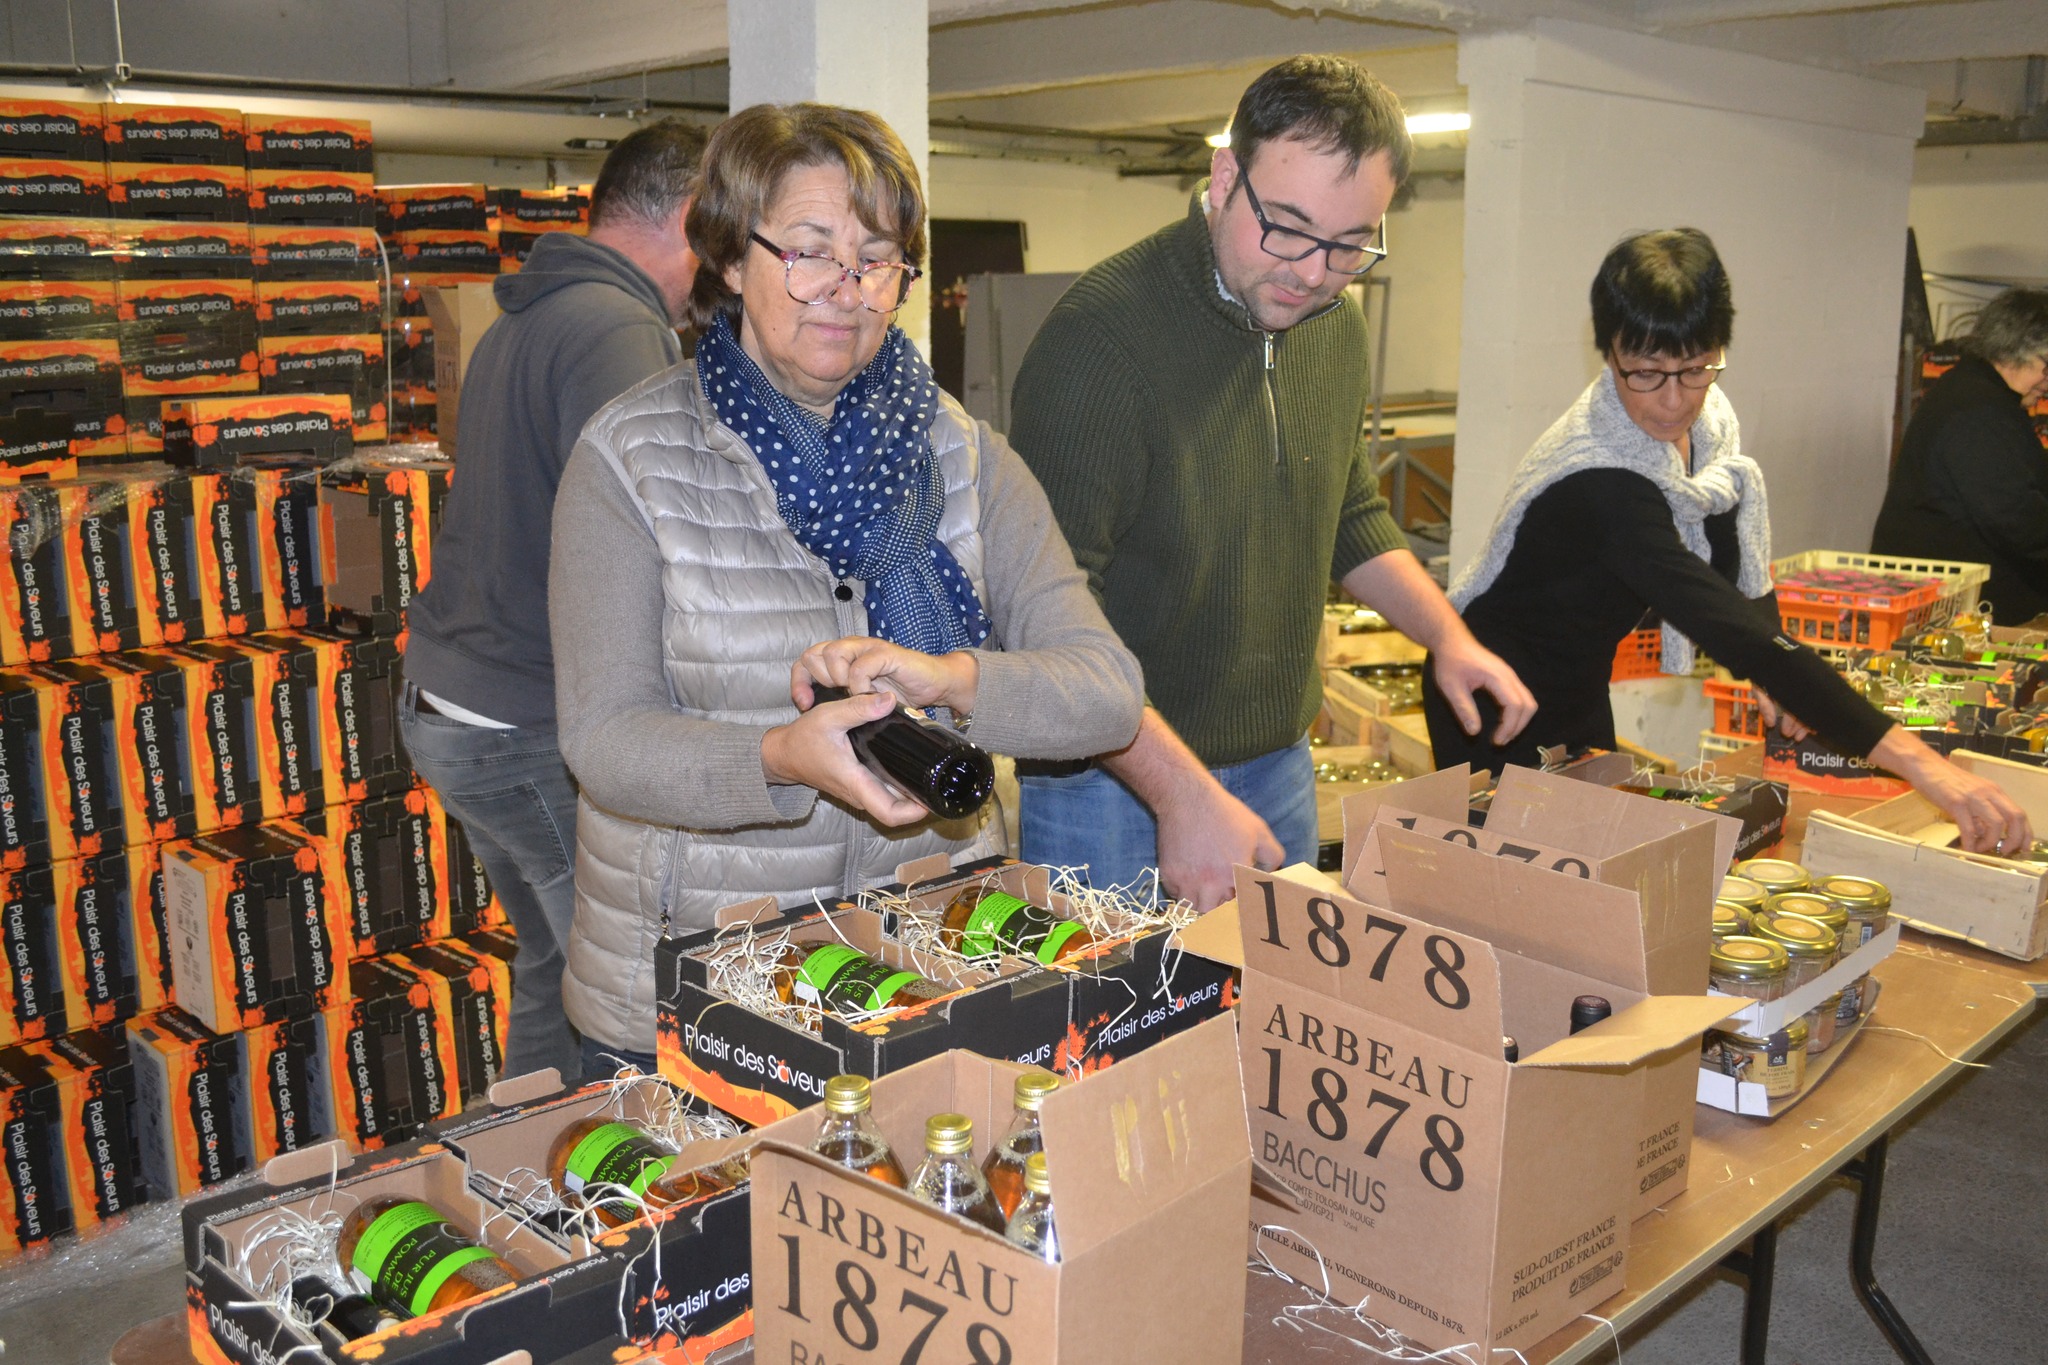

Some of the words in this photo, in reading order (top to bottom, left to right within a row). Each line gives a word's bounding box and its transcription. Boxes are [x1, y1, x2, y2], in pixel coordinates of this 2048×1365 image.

[20, 123, 42, 135] des
[43, 123, 76, 135] Plaisir
[24, 183, 47, 195] des
[48, 183, 81, 194] Plaisir
[275, 304, 312, 316] Saveurs
[313, 303, 331, 313] des
[331, 300, 359, 312] Plaisir
[145, 362, 175, 376] Plaisir
[176, 361, 196, 374] des
[196, 358, 236, 371] Saveurs
[280, 358, 317, 372] Saveurs
[317, 356, 335, 368] des
[336, 353, 363, 367] Plaisir
[223, 425, 270, 440] Saveurs
[270, 421, 293, 435] des
[295, 418, 329, 434] Plaisir
[22, 443, 37, 454] des
[37, 439, 67, 451] Saveurs
[152, 509, 168, 546] Plaisir
[217, 504, 233, 539] Plaisir
[279, 499, 293, 534] Plaisir
[393, 500, 406, 548] Saveurs
[16, 523, 30, 560] Plaisir
[87, 516, 102, 554] Plaisir
[222, 540, 234, 564] des
[283, 534, 296, 559] des
[22, 562, 36, 586] des
[92, 554, 106, 579] des
[158, 547, 171, 571] des
[396, 547, 409, 570] des
[162, 571, 178, 619] Saveurs
[226, 564, 241, 611] Saveurs
[287, 559, 302, 605] Saveurs
[396, 571, 409, 608] Plaisir
[27, 587, 44, 637] Saveurs
[97, 579, 114, 628] Saveurs
[277, 683, 292, 719] Plaisir
[340, 672, 356, 708] Plaisir
[140, 705, 156, 743] Plaisir
[212, 693, 227, 730] Plaisir
[344, 708, 357, 732] des
[67, 716, 85, 754] Plaisir
[217, 730, 230, 754] des
[281, 720, 294, 744] des
[73, 756, 87, 781] des
[147, 744, 160, 768] des
[285, 743, 300, 791] Saveurs
[347, 732, 361, 779] Saveurs
[1802, 752, 1845, 769] Plaisir
[151, 768, 168, 818] Saveurs
[221, 755, 236, 804] Saveurs
[2, 794, 19, 845] Saveurs
[78, 781, 94, 831] Saveurs
[350, 832, 365, 866] Plaisir
[412, 819, 425, 864] Saveurs
[354, 868, 369, 891] des
[416, 863, 428, 886] des
[473, 875, 488, 908] Plaisir
[82, 888, 98, 925] Plaisir
[232, 893, 249, 930] Plaisir
[303, 877, 318, 926] Saveurs
[357, 890, 371, 935] Saveurs
[418, 886, 432, 920] Plaisir
[9, 904, 25, 942] Plaisir
[88, 926, 101, 951] des
[309, 925, 322, 948] des
[15, 942, 29, 970] des
[238, 931, 251, 956] des
[1254, 879, 1471, 1011] 1878
[92, 951, 109, 999] Saveurs
[241, 955, 258, 1004] Saveurs
[312, 950, 327, 986] Plaisir
[866, 967, 889, 981] PUR
[20, 968, 38, 1016] Saveurs
[476, 995, 491, 1041] Saveurs
[1098, 1019, 1138, 1050] Plaisir
[1140, 1005, 1167, 1030] des
[1168, 982, 1219, 1016] Saveurs
[351, 1030, 367, 1065] Plaisir
[416, 1012, 433, 1059] Saveurs
[482, 1039, 494, 1063] des
[274, 1051, 291, 1087] Plaisir
[423, 1057, 436, 1080] des
[684, 1023, 730, 1062] Plaisir
[733, 1045, 766, 1075] des
[767, 1054, 827, 1098] Saveur
[1263, 1003, 1474, 1110] ARBEAU
[195, 1072, 214, 1107] Plaisir
[357, 1065, 369, 1089] des
[279, 1087, 291, 1112] des
[361, 1087, 377, 1133] Saveurs
[426, 1081, 441, 1114] Plaisir
[89, 1100, 108, 1138] Plaisir
[201, 1108, 215, 1133] des
[282, 1110, 297, 1151] Saveur
[1258, 1046, 1466, 1192] 1878
[1645, 1121, 1680, 1149] FRANCE
[10, 1122, 29, 1160] Plaisir
[96, 1139, 111, 1164] des
[204, 1131, 222, 1181] Saveurs
[1646, 1137, 1679, 1165] FRANCE
[18, 1161, 33, 1187] des
[626, 1153, 651, 1172] PUR
[1263, 1130, 1387, 1214] BACCHUS
[101, 1162, 120, 1212] Saveurs
[1287, 1180, 1313, 1199] COMTE
[1315, 1191, 1348, 1216] TOLOSAN
[1349, 1209, 1376, 1229] ROUGE
[22, 1185, 42, 1236] Saveurs
[382, 1237, 418, 1285] POMME
[412, 1249, 437, 1273] PUR
[777, 1180, 1019, 1317] ARBEAU
[1513, 1240, 1575, 1284] SUD-OUEST
[1576, 1215, 1616, 1248] FRANCE
[391, 1271, 404, 1291] DE
[1248, 1220, 1290, 1247] FAMILLE
[1335, 1262, 1397, 1301] VIGNERONS
[1398, 1294, 1439, 1322] DEPUIS
[1441, 1315, 1466, 1336] 1878.
[1511, 1264, 1561, 1302] PRODUIT
[1560, 1257, 1576, 1274] DE
[1576, 1232, 1615, 1264] FRANCE
[400, 1273, 414, 1298] JUS
[655, 1285, 710, 1329] Plaisir
[714, 1272, 751, 1301] des
[210, 1302, 249, 1354] Plaisir
